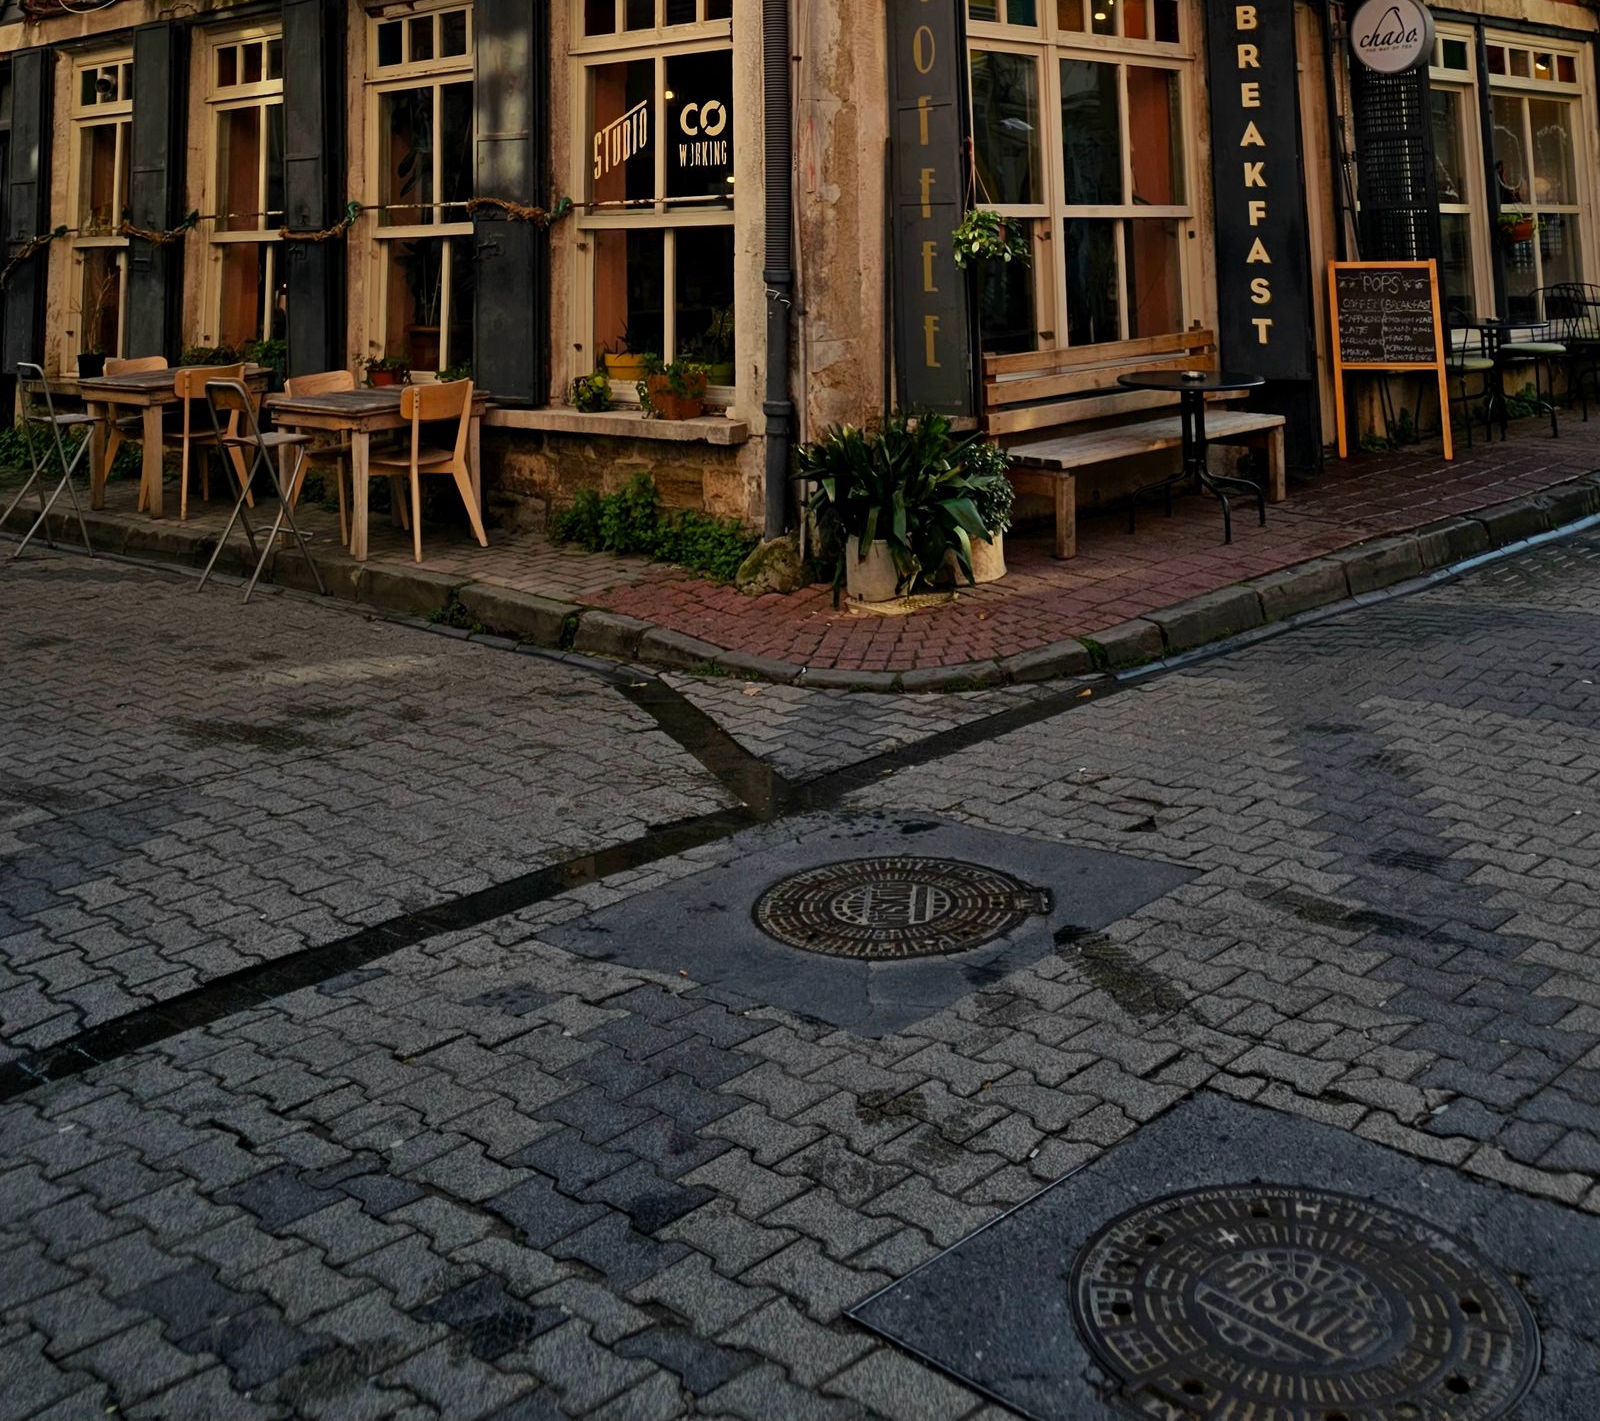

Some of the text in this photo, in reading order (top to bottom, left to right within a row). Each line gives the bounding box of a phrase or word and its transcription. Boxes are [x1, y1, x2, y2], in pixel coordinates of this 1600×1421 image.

[593, 99, 648, 180] STUDIO
[679, 99, 727, 137] CO
[1235, 5, 1273, 344] BREAKFAST
[1363, 275, 1401, 294] POPS
